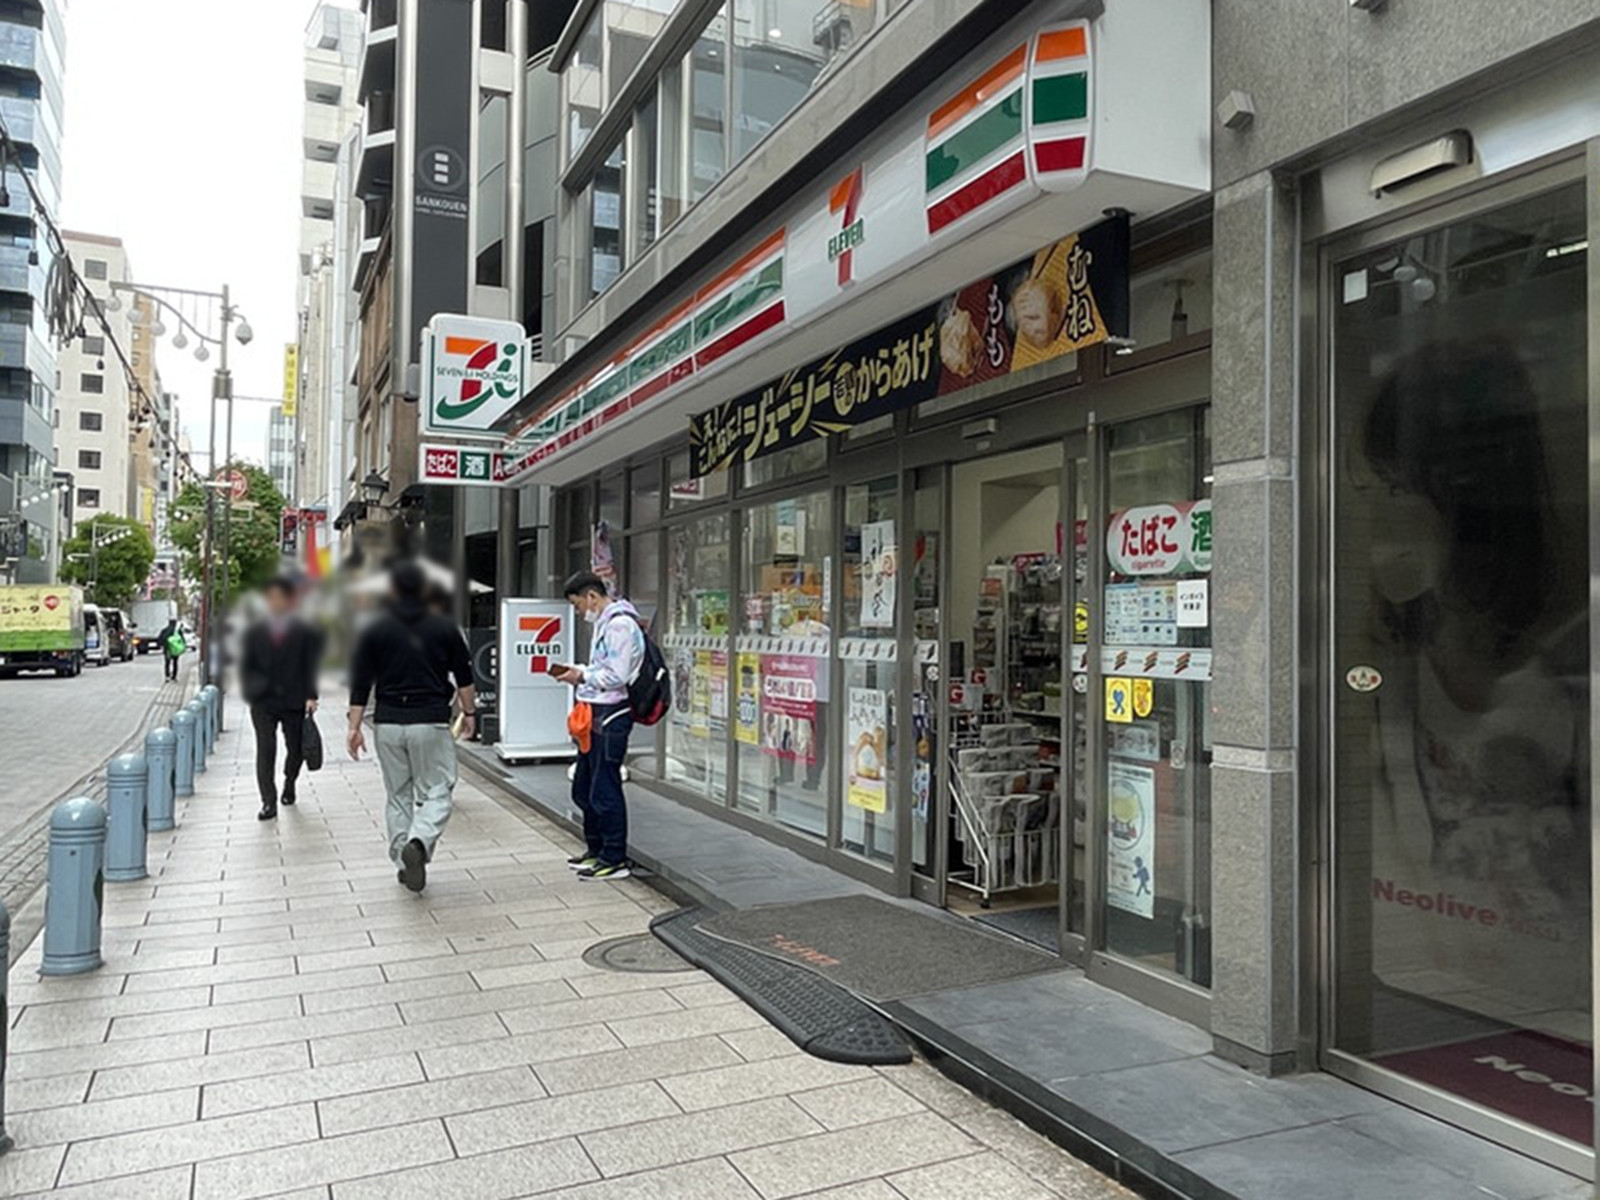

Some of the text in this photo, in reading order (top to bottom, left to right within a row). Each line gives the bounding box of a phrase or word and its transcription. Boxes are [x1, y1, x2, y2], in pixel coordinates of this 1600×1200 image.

[416, 195, 467, 212] SANKOUEN
[1067, 244, 1094, 340] むね
[987, 283, 1005, 368] もも
[426, 452, 457, 475] たばこ
[465, 455, 485, 476] 酒
[1121, 514, 1179, 557] たばこ
[1371, 877, 1500, 927] Neolive
[1473, 1054, 1594, 1103] Neo
